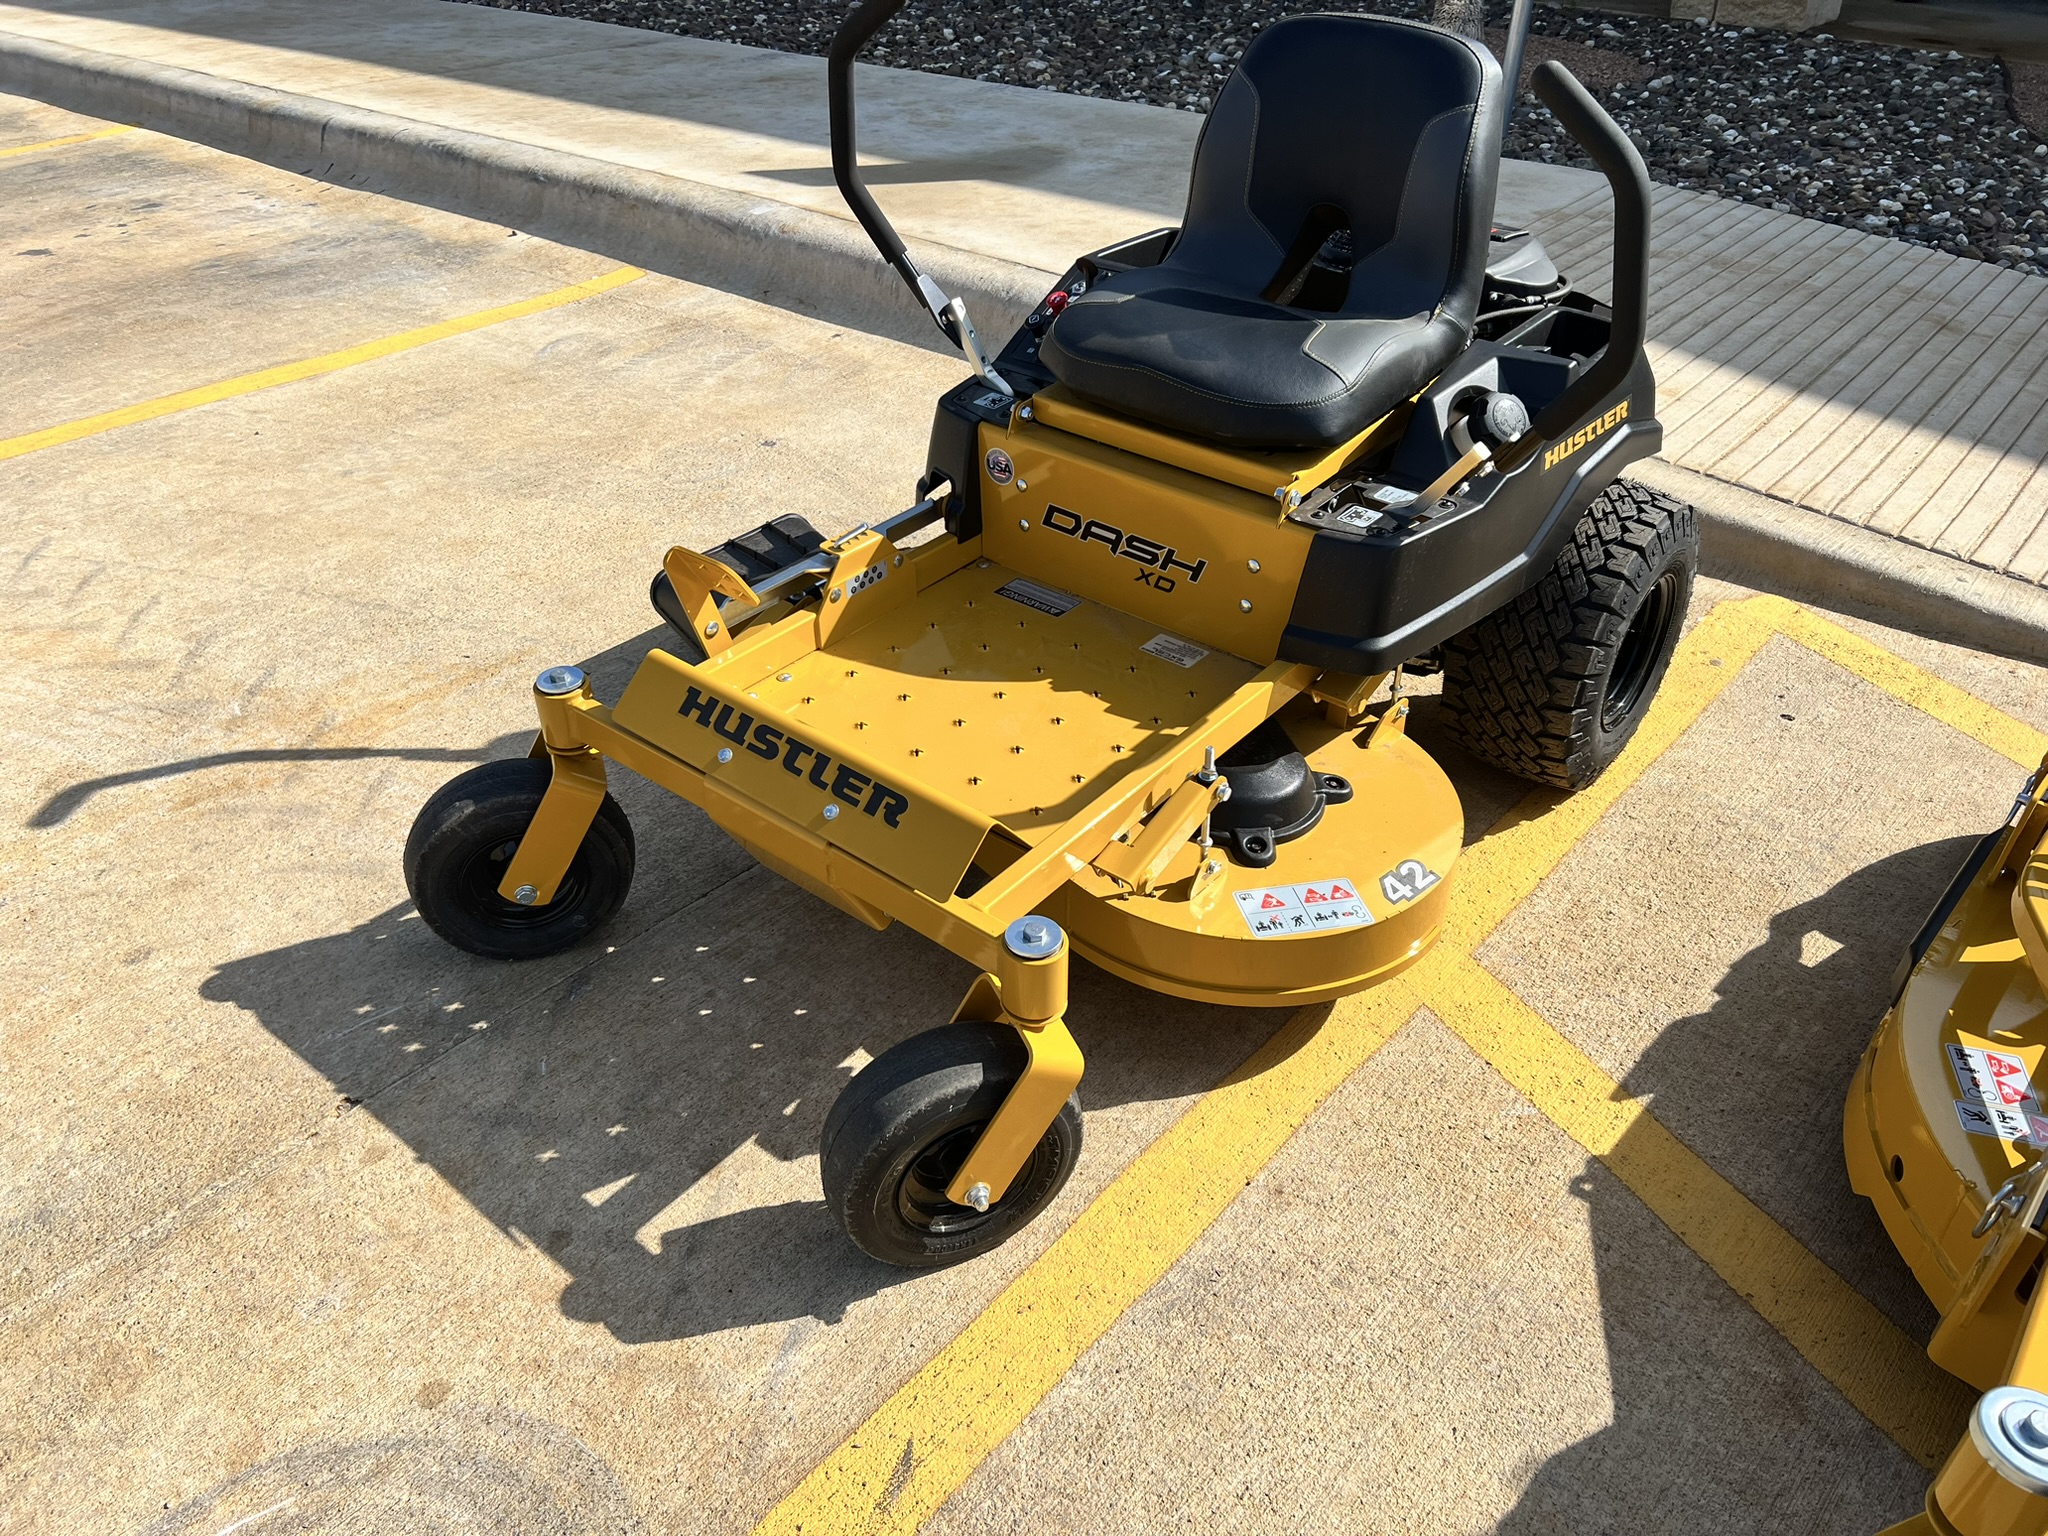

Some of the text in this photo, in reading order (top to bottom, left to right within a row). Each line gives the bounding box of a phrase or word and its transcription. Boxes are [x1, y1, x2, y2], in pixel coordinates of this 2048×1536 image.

[1544, 399, 1630, 471] HUSTLER
[986, 458, 1013, 476] USA
[1041, 502, 1209, 585] DASH
[1134, 567, 1177, 594] XD
[677, 685, 910, 830] HUSTLER
[1382, 860, 1438, 904] 42
